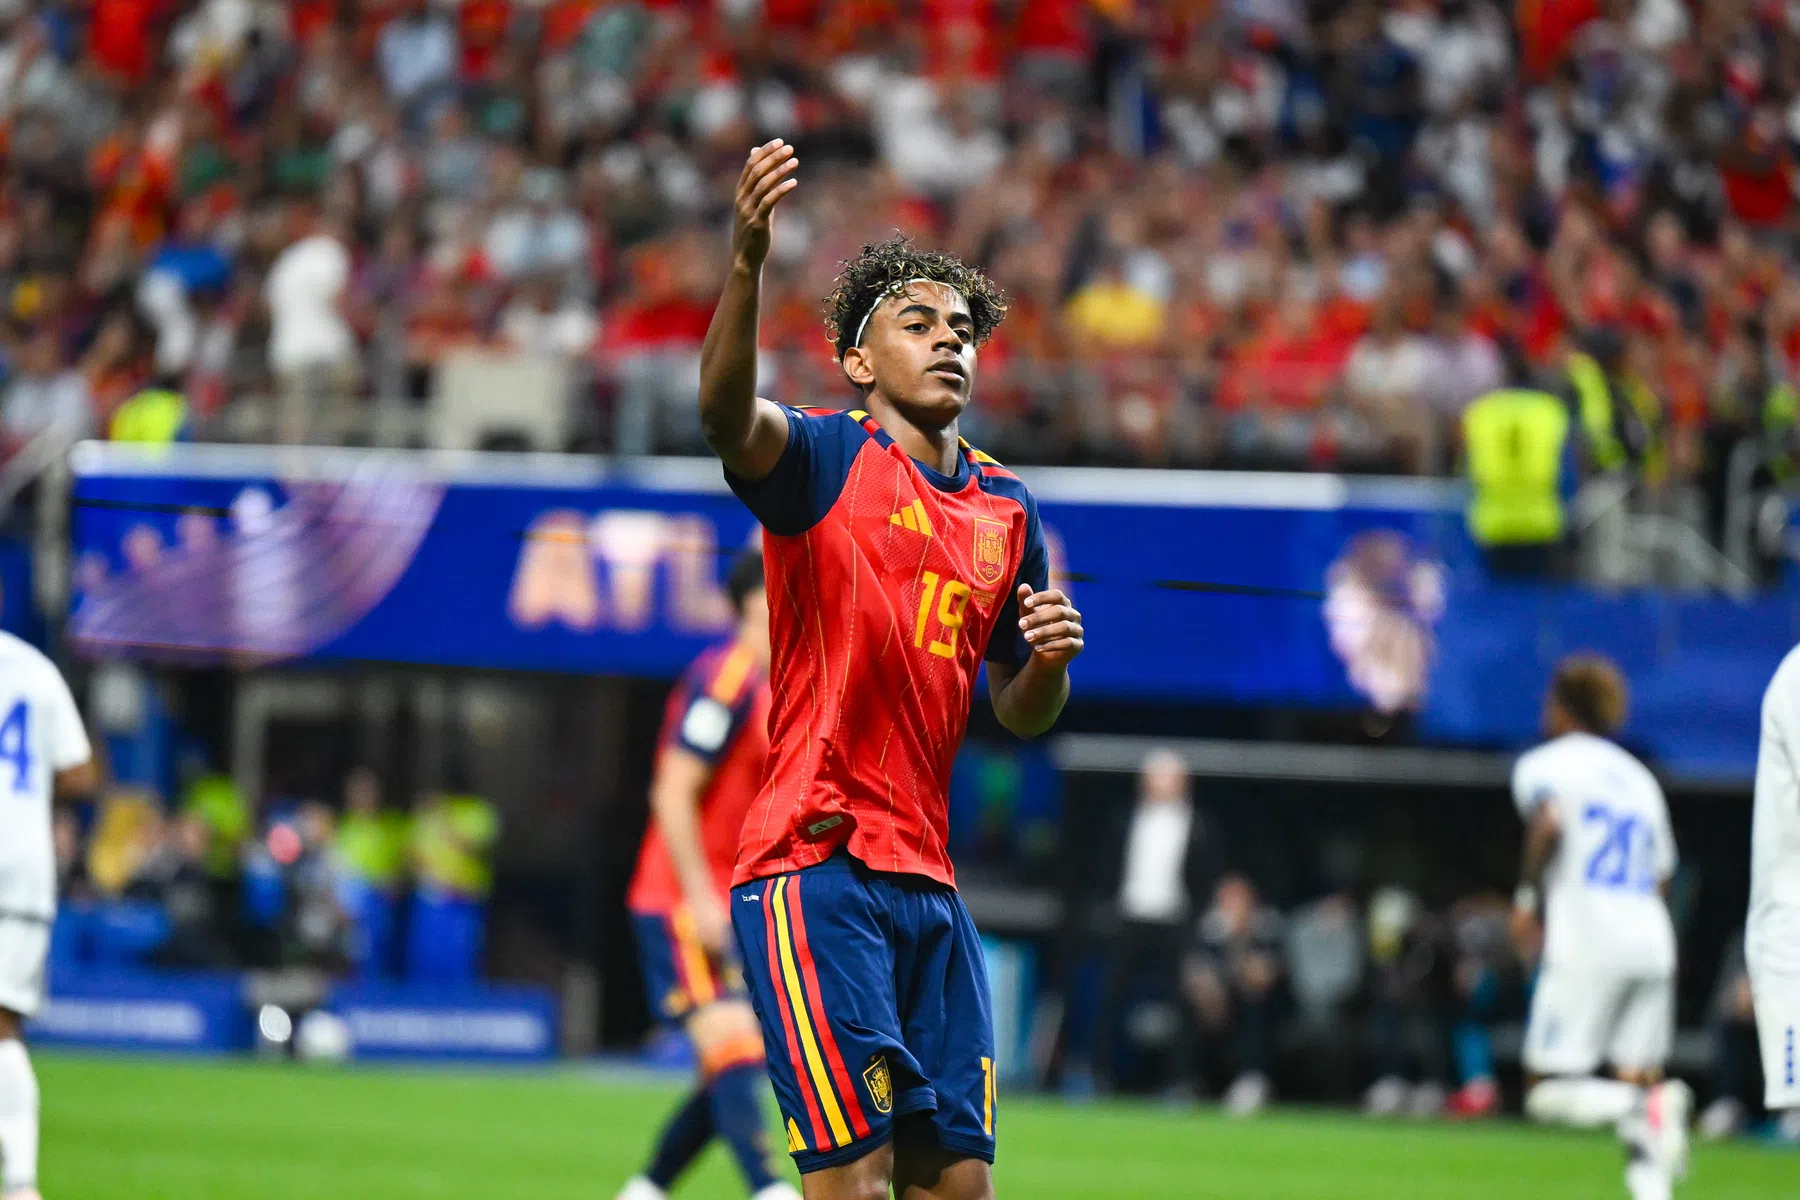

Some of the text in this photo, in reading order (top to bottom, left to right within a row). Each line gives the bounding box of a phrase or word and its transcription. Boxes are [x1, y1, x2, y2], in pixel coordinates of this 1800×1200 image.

[506, 509, 764, 631] ATL
[914, 570, 971, 658] 19
[1581, 803, 1656, 893] 20
[980, 1056, 997, 1136] 1
